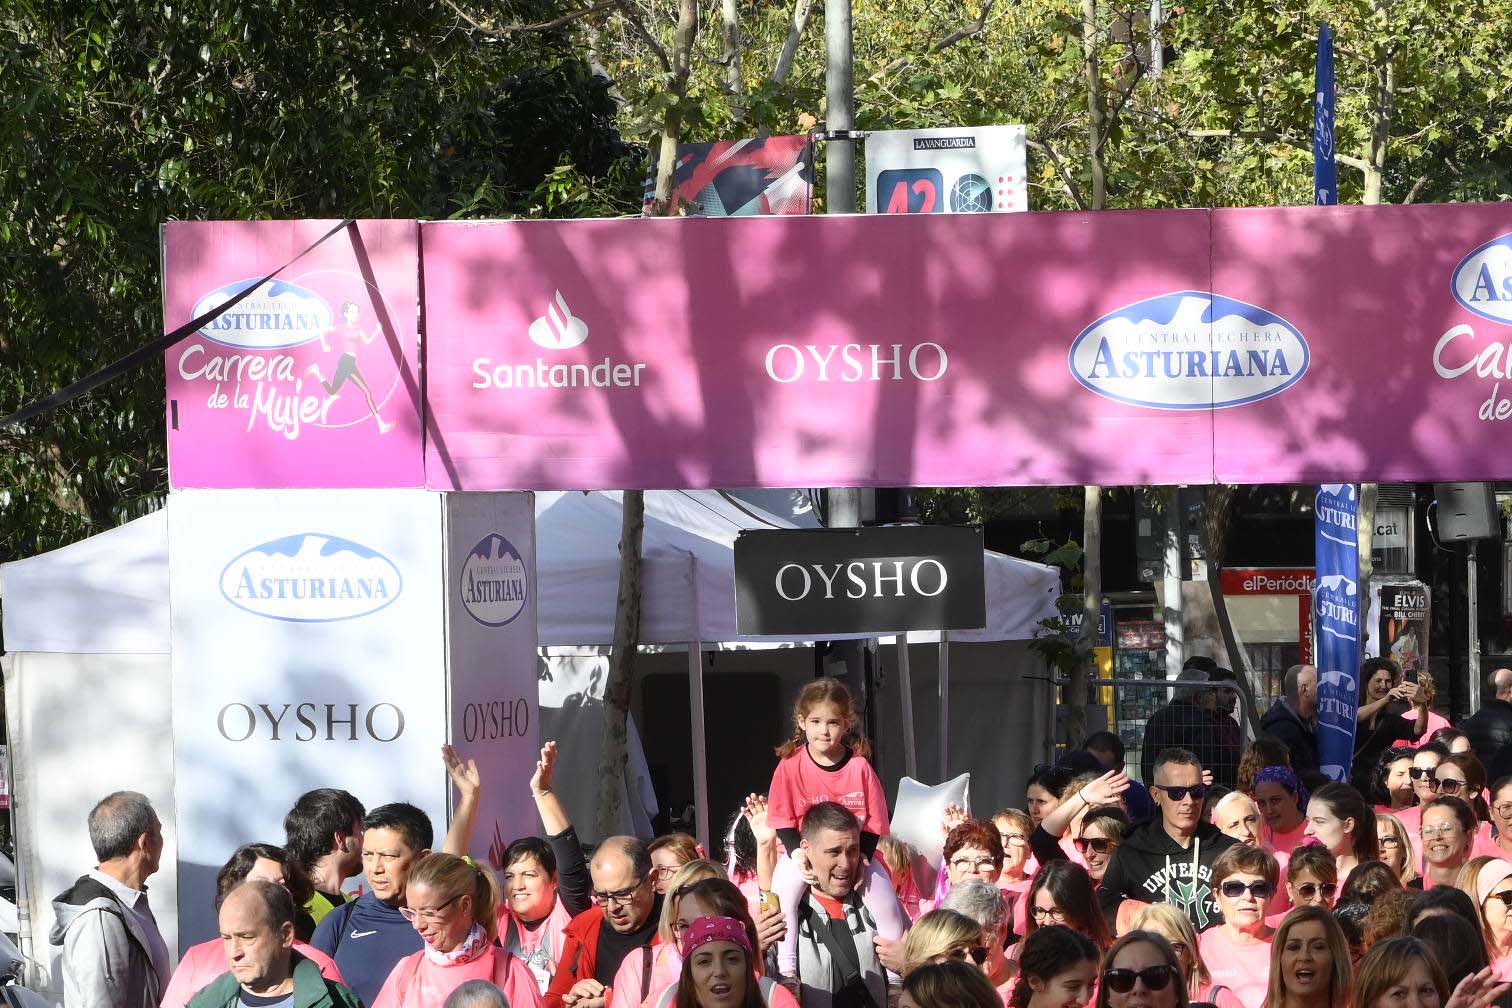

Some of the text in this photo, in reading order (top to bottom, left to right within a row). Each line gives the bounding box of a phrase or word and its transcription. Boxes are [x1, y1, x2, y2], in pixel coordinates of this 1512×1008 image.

[1207, 332, 1283, 343] LECHERA
[179, 344, 296, 382] Carrera
[472, 357, 646, 389] Santander
[765, 342, 949, 384] OYSHO
[1088, 337, 1292, 380] ASTURIANA
[208, 379, 342, 440] de la Mujer
[234, 566, 389, 599] ASTURIANA
[465, 568, 524, 603] ASTURIANA
[775, 558, 949, 601] OYSHO
[1394, 594, 1425, 608] ELVIS
[215, 702, 406, 742] OYSHO
[463, 698, 529, 743] OYSHO
